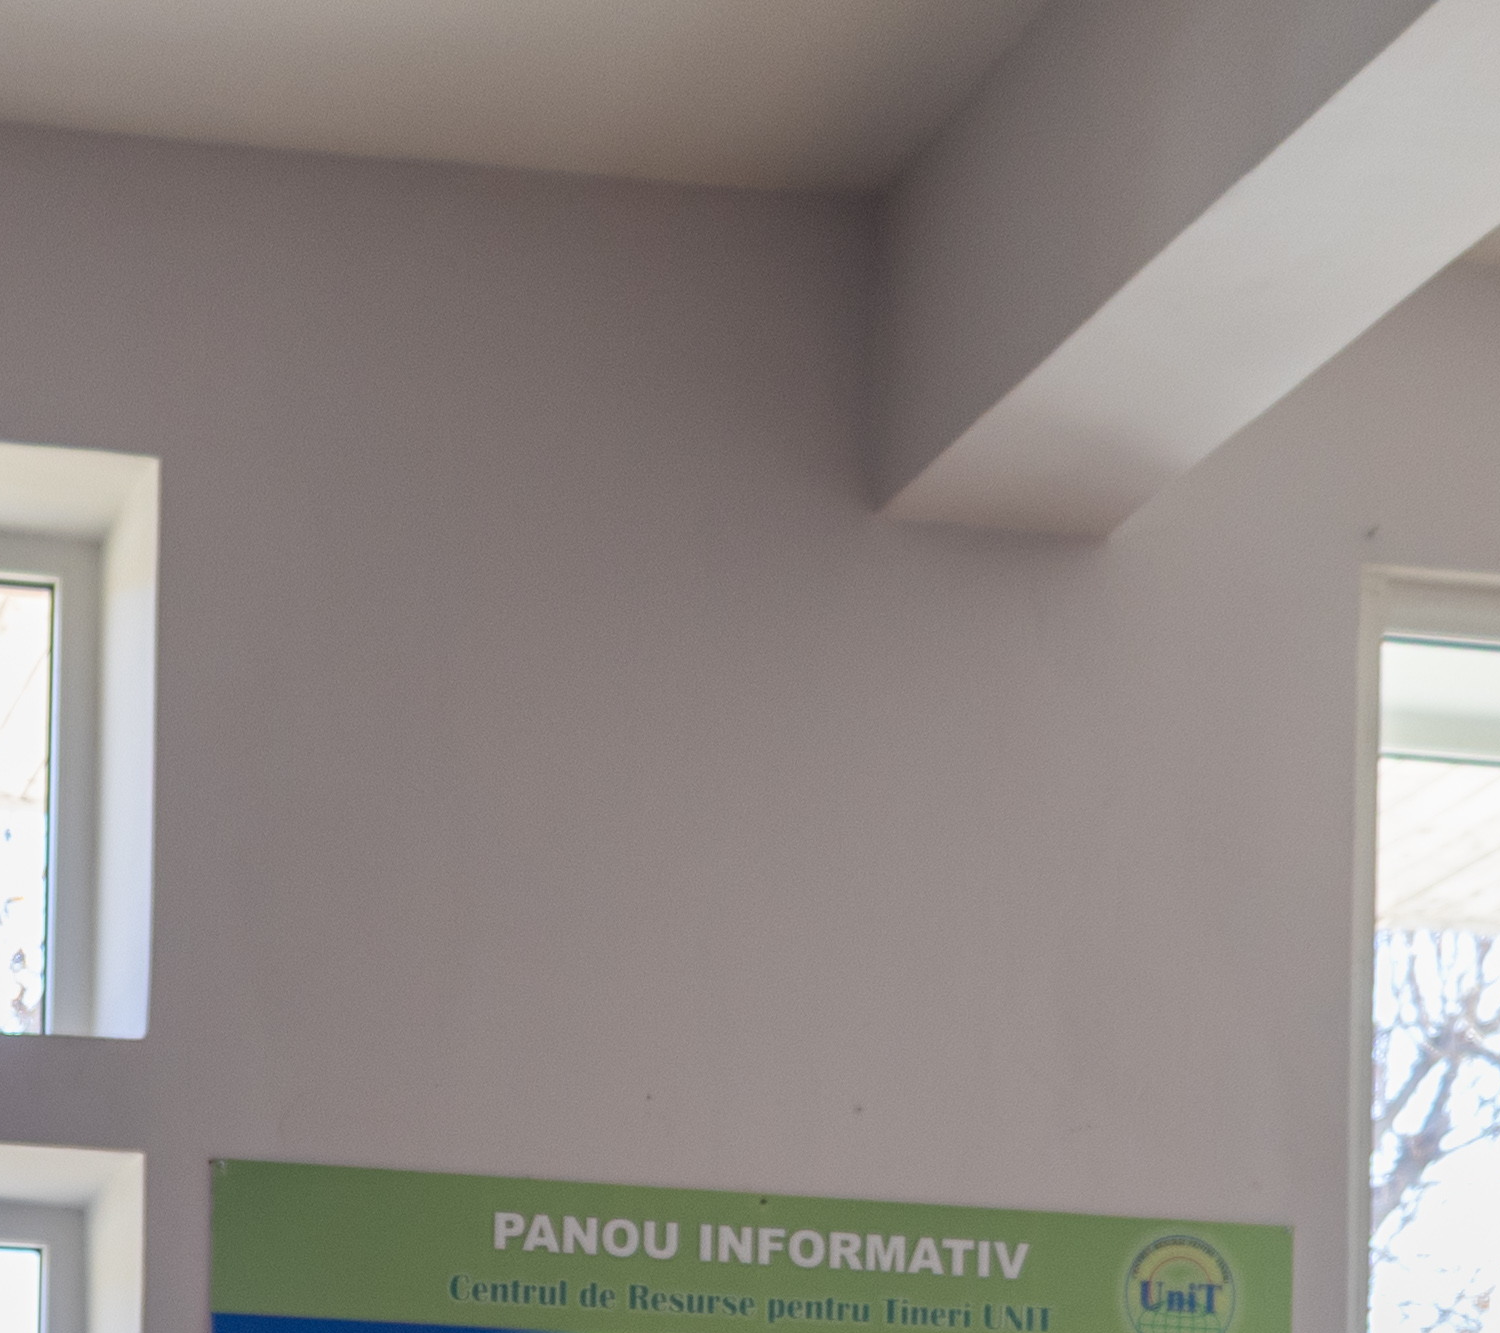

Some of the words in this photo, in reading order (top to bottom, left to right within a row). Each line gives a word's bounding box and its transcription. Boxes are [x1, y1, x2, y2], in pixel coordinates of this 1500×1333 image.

[493, 1211, 681, 1260] PANOU
[699, 1223, 1031, 1280] INFORMATIV
[449, 1273, 568, 1308] Centrul
[579, 1277, 617, 1310] de
[628, 1284, 756, 1318] Resurse
[767, 1291, 872, 1326] pentru
[885, 1296, 973, 1329] Tineri
[983, 1303, 1054, 1333] UNIT
[1140, 1280, 1223, 1315] UniT
